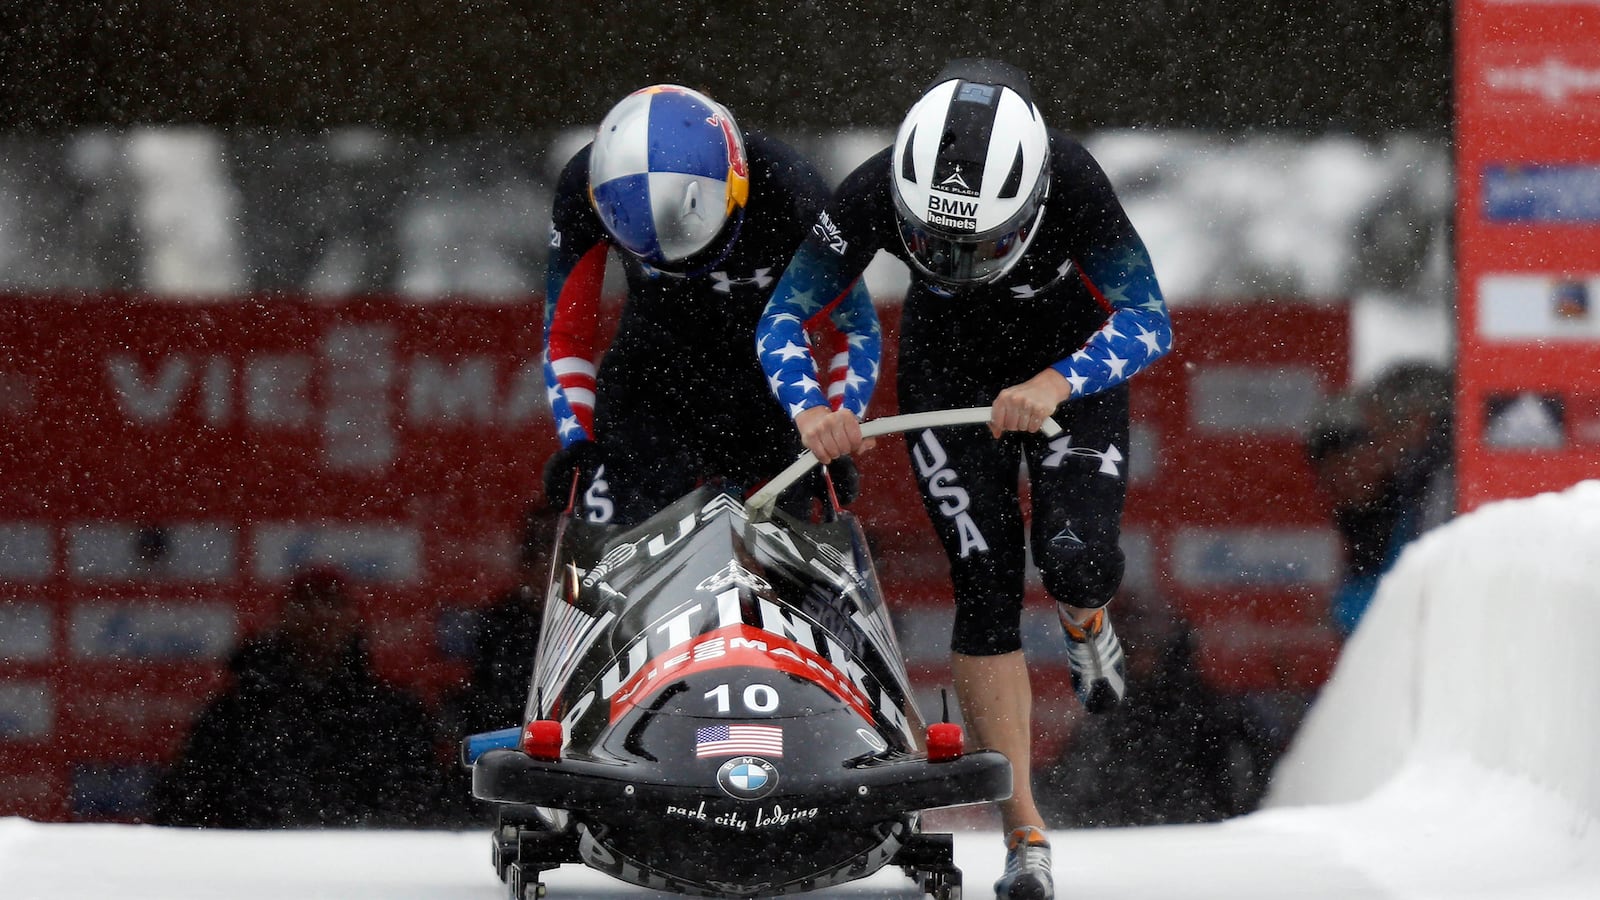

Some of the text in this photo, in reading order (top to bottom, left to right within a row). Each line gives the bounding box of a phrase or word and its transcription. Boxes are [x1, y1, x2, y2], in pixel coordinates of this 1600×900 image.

[931, 183, 980, 196] LAKE PLACID
[929, 194, 979, 217] BMW
[928, 211, 976, 230] helmets
[912, 427, 989, 559] USA
[560, 588, 919, 757] PUTINKA
[615, 636, 865, 707] VIESSMANN
[704, 684, 780, 713] 10
[723, 757, 774, 772] BMW
[666, 801, 819, 831] park city lodging
